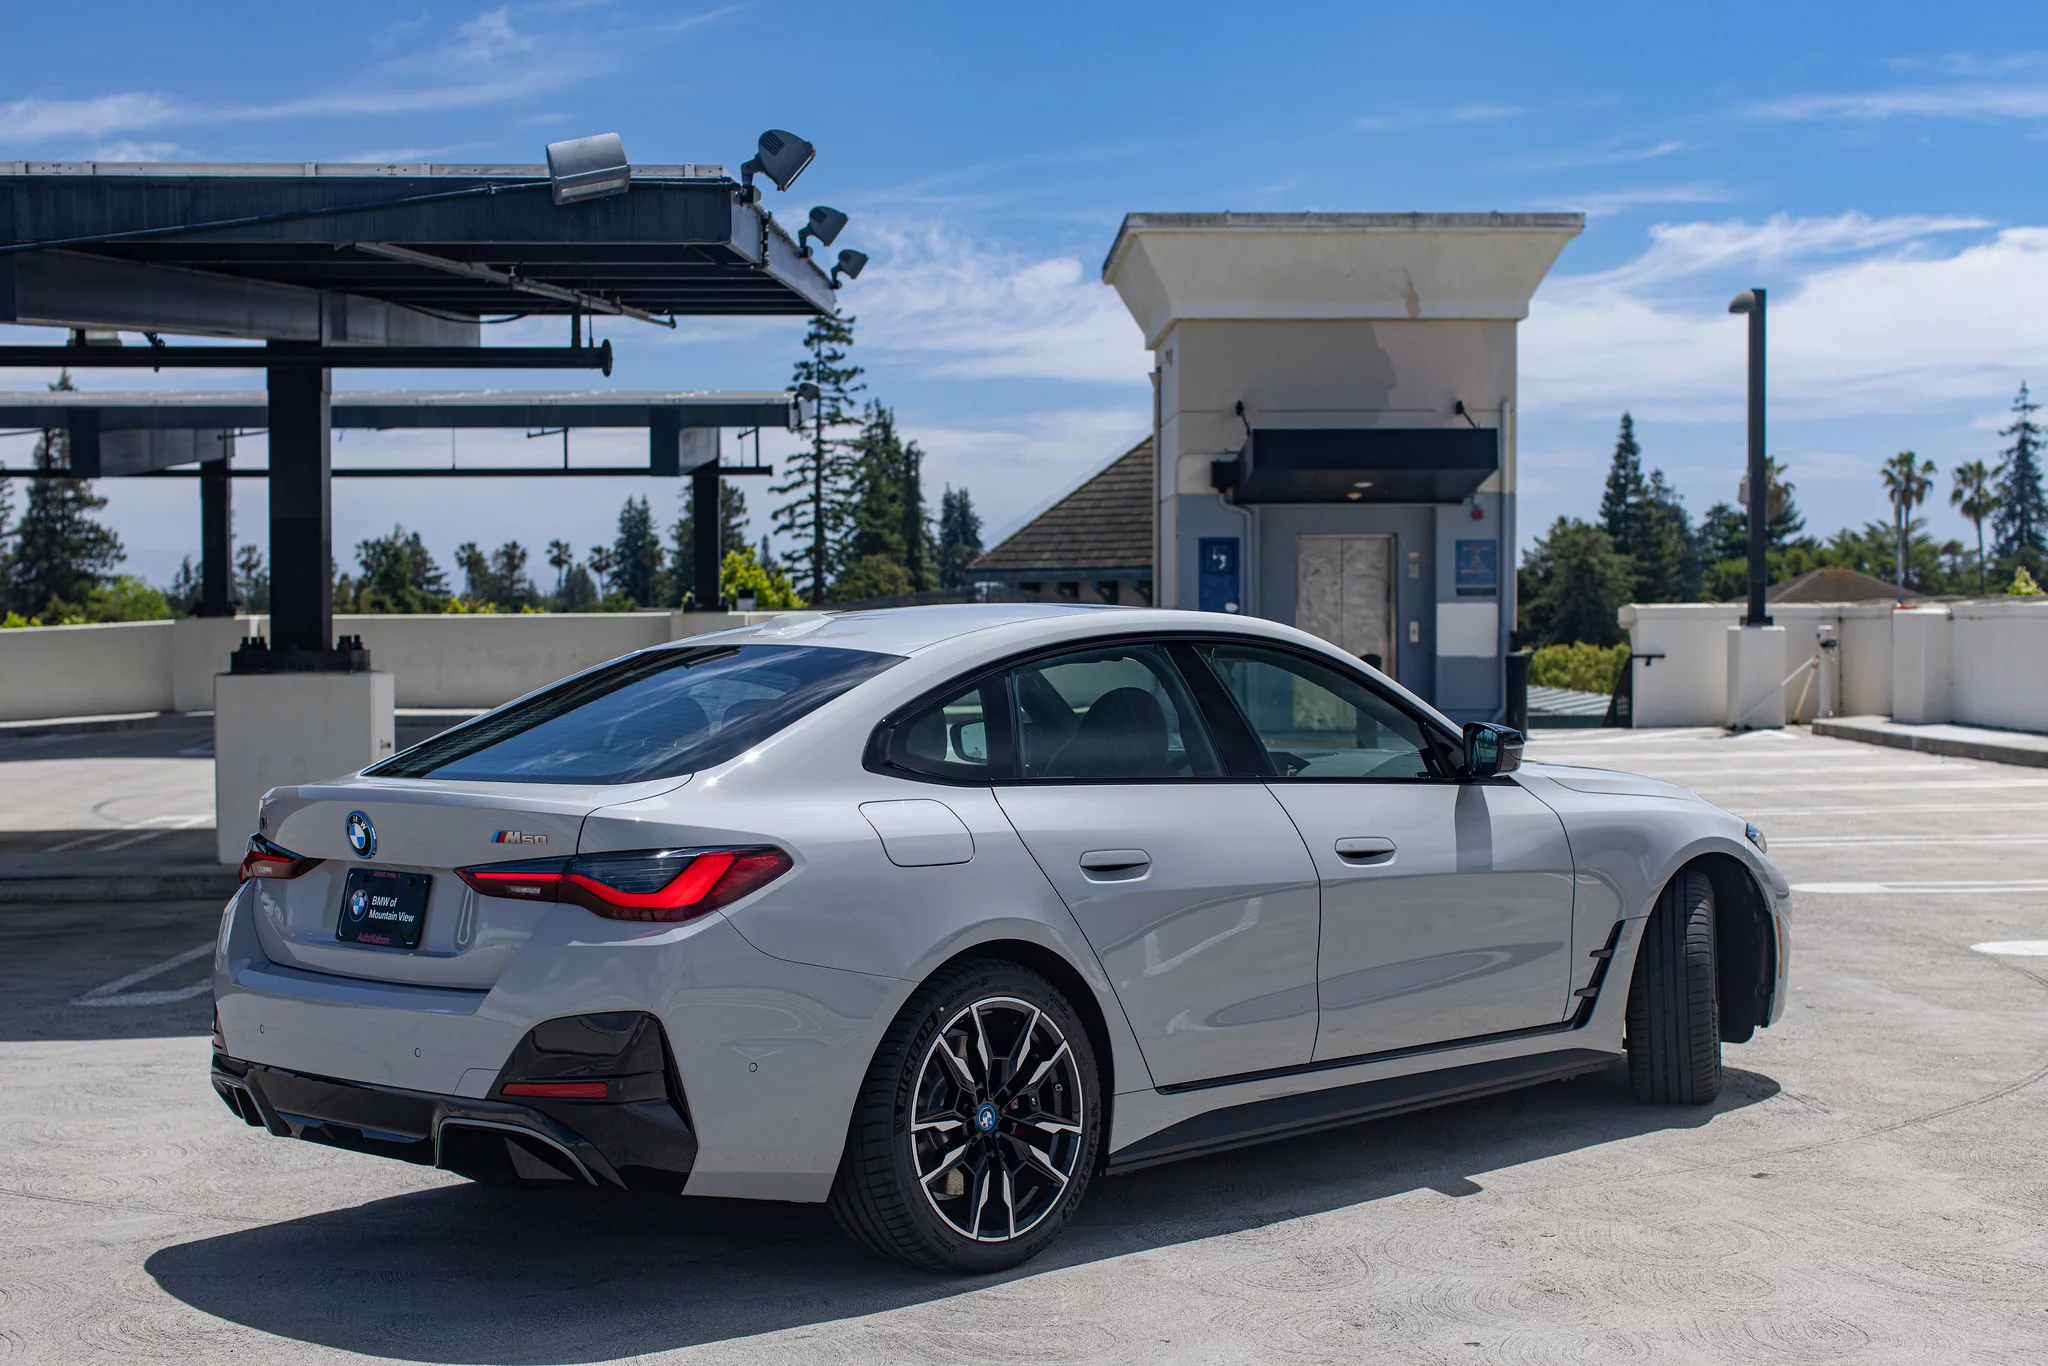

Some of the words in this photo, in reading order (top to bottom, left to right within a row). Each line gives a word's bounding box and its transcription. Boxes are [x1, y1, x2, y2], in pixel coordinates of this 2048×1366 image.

[371, 895, 389, 907] BMW
[389, 897, 398, 908] of
[368, 908, 398, 921] Mountain
[398, 911, 415, 922] View
[356, 932, 390, 945] AutoNation
[896, 1012, 938, 1106] MICHELIN
